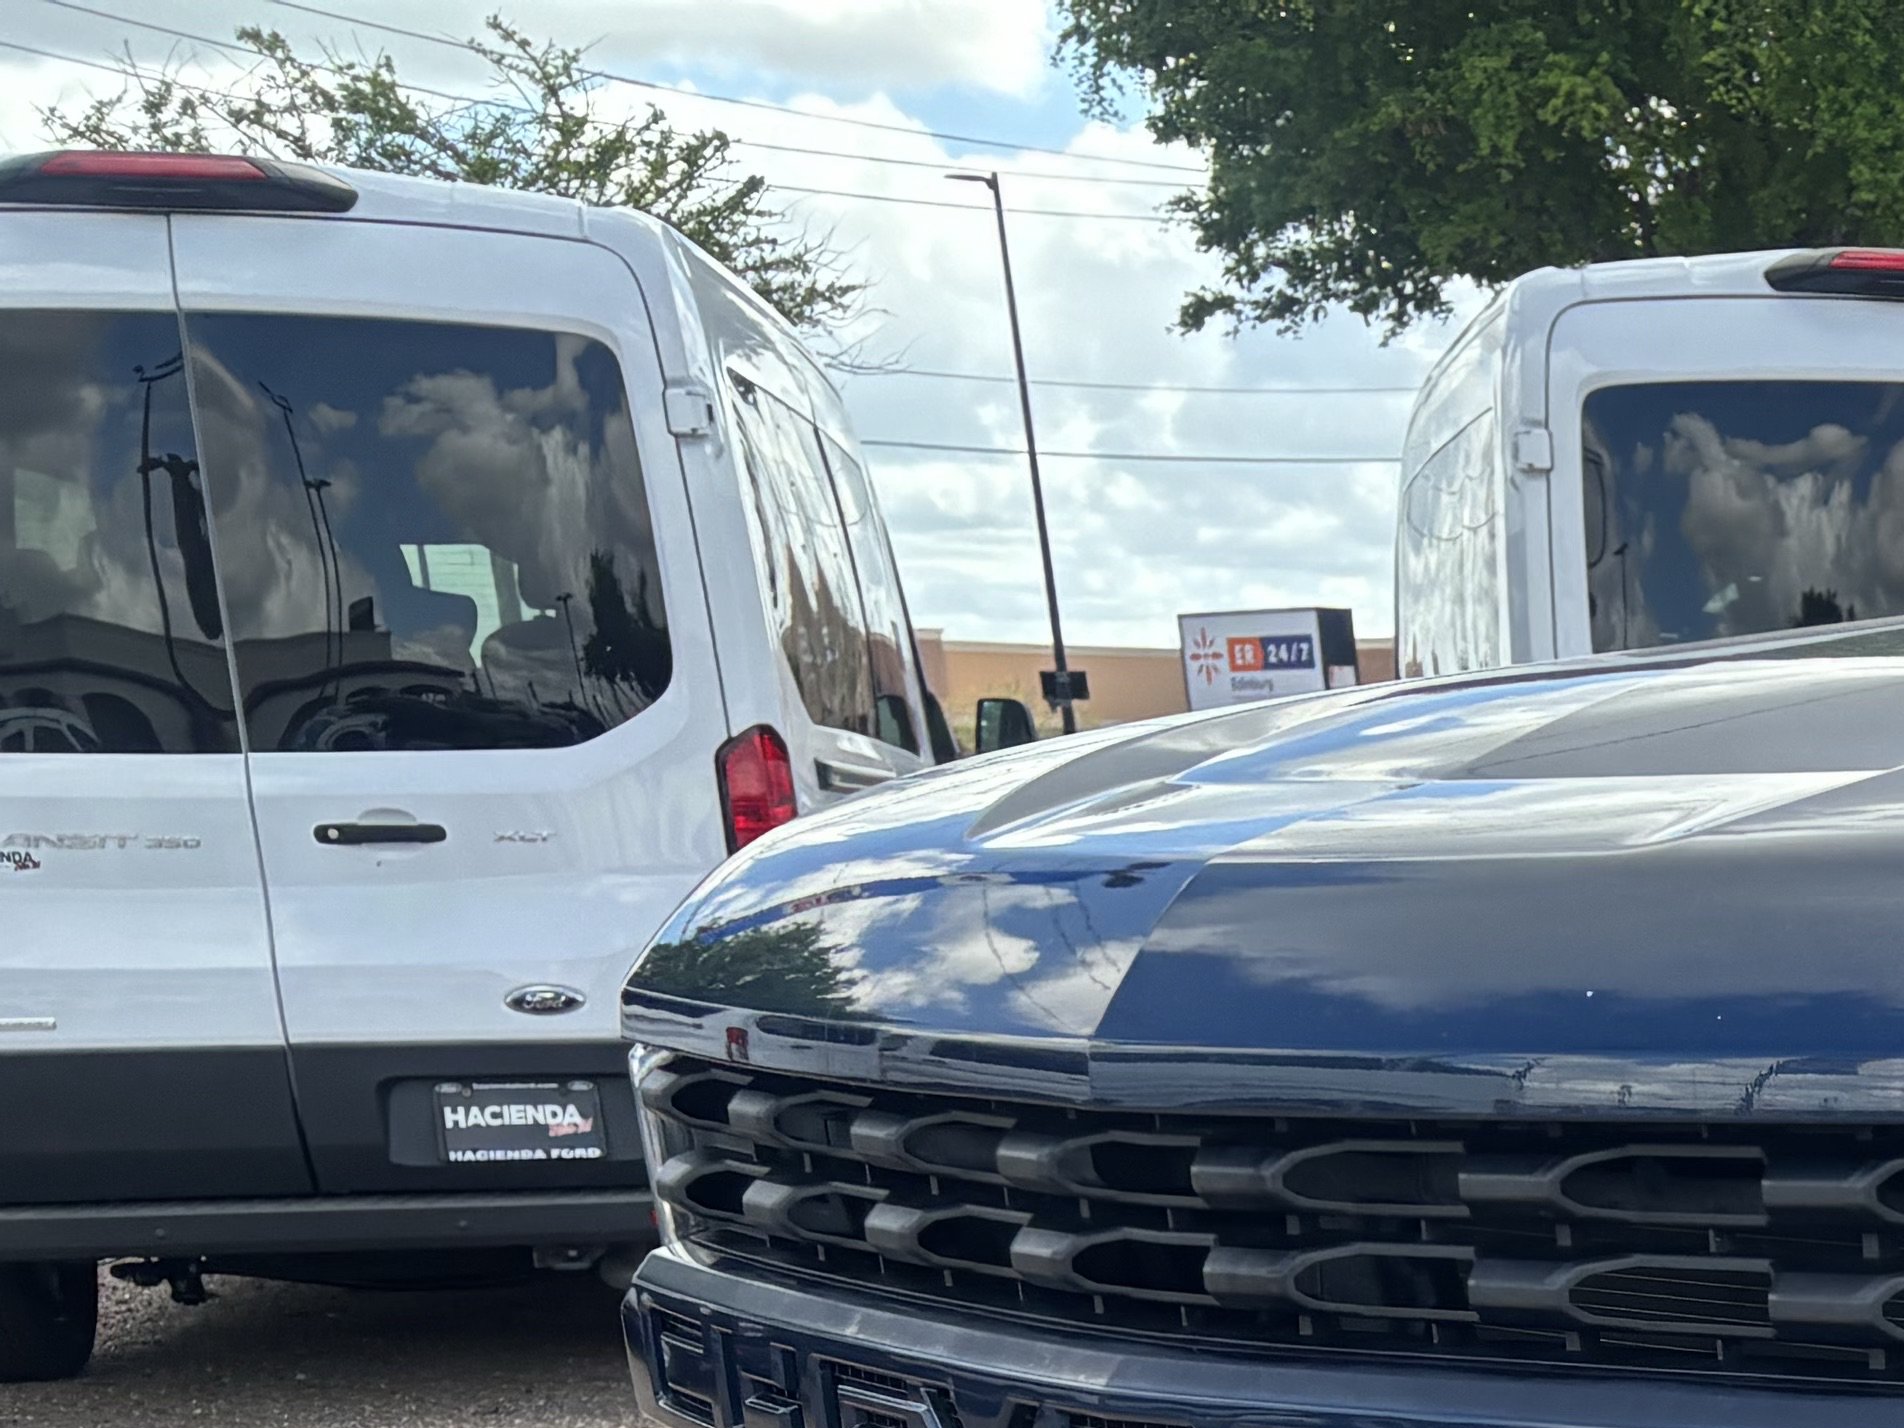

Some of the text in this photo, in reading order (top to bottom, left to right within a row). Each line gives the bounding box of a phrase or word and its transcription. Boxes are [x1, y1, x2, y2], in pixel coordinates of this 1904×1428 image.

[1234, 642, 1310, 665] ER 24/7
[443, 1104, 583, 1130] HACIENDA
[449, 1147, 601, 1162] HACIENDA FORD
